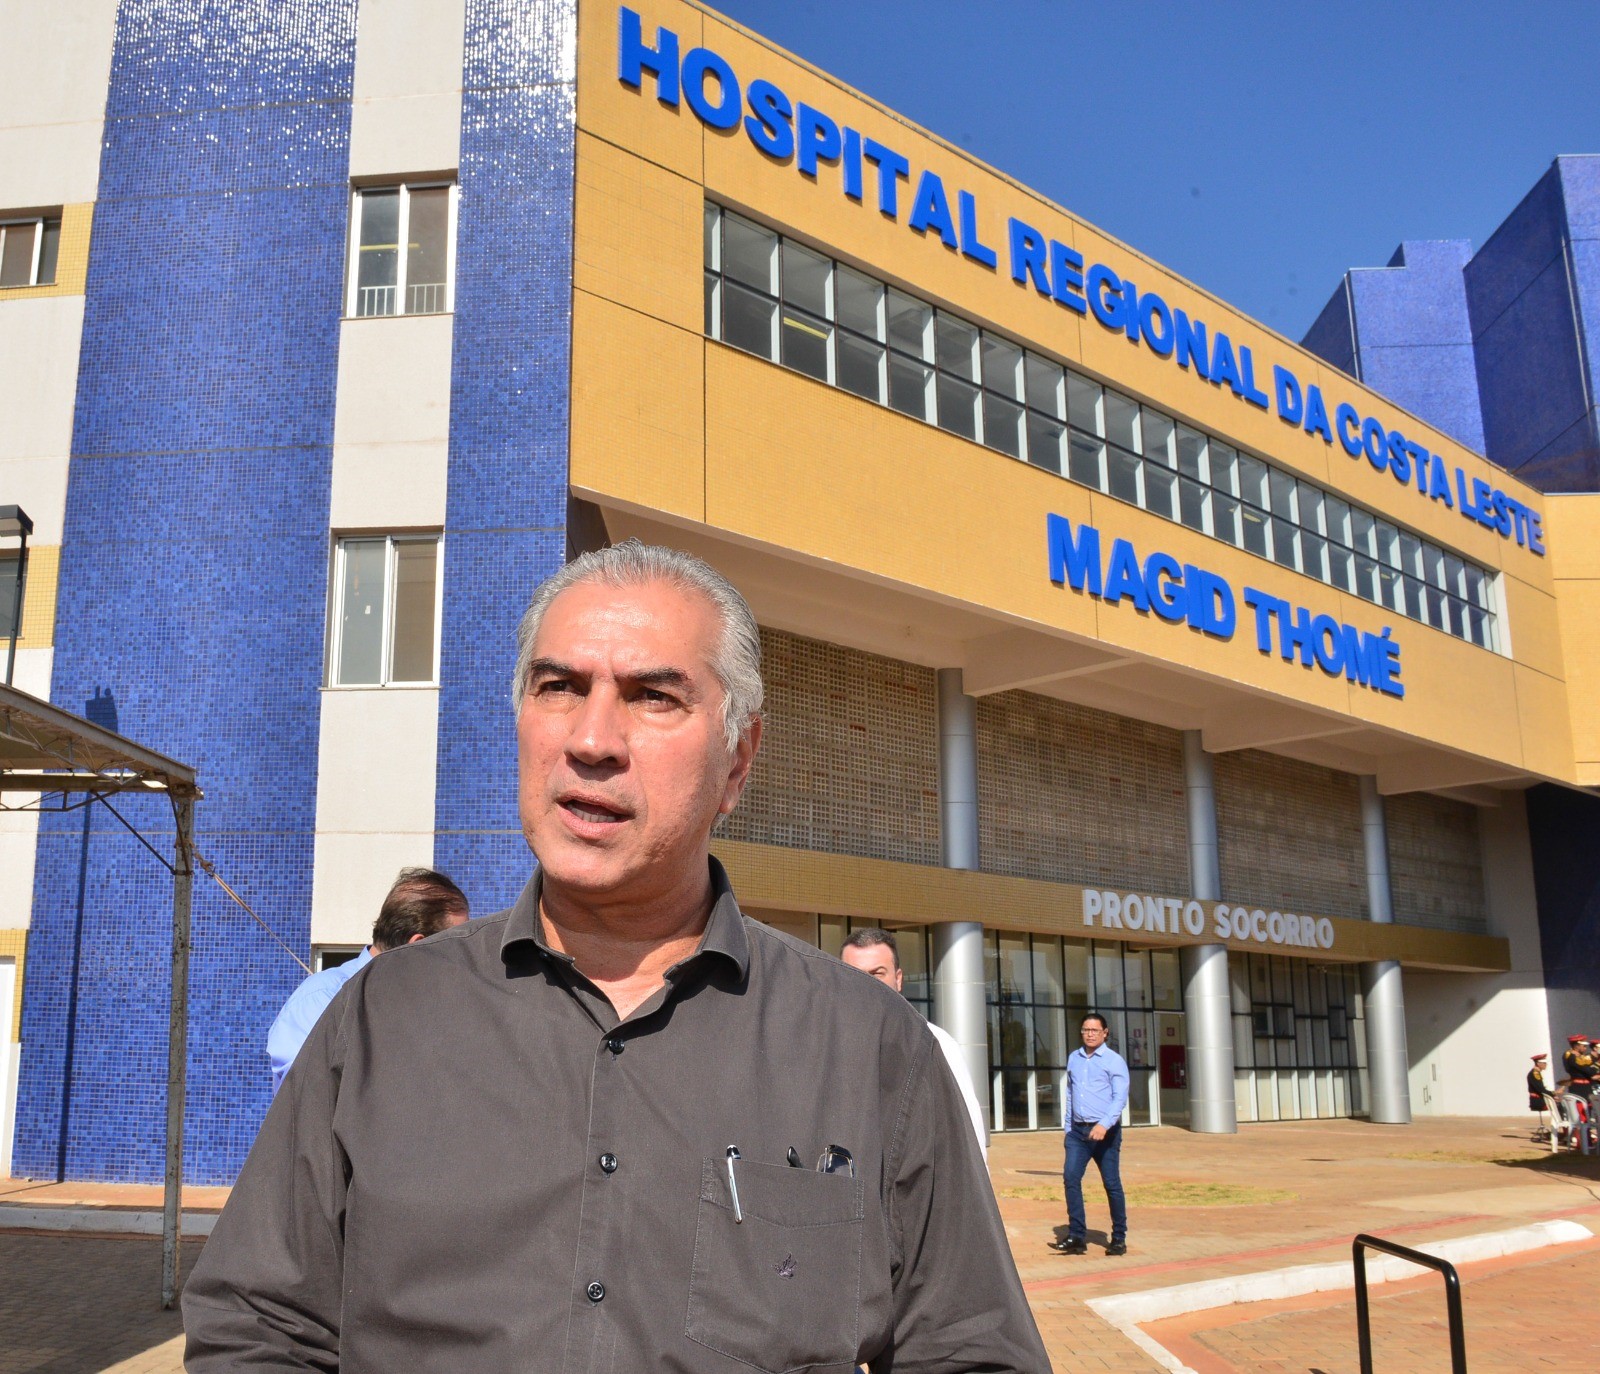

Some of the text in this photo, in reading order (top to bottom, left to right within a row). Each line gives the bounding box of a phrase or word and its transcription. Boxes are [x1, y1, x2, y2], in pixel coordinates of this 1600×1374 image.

[618, 5, 1545, 556] HOSPITAL REGIONAL DA COSTA LESTE
[1047, 512, 1405, 698] MAGID THOMÉ
[1082, 888, 1335, 949] PRONTO SOCORRO
